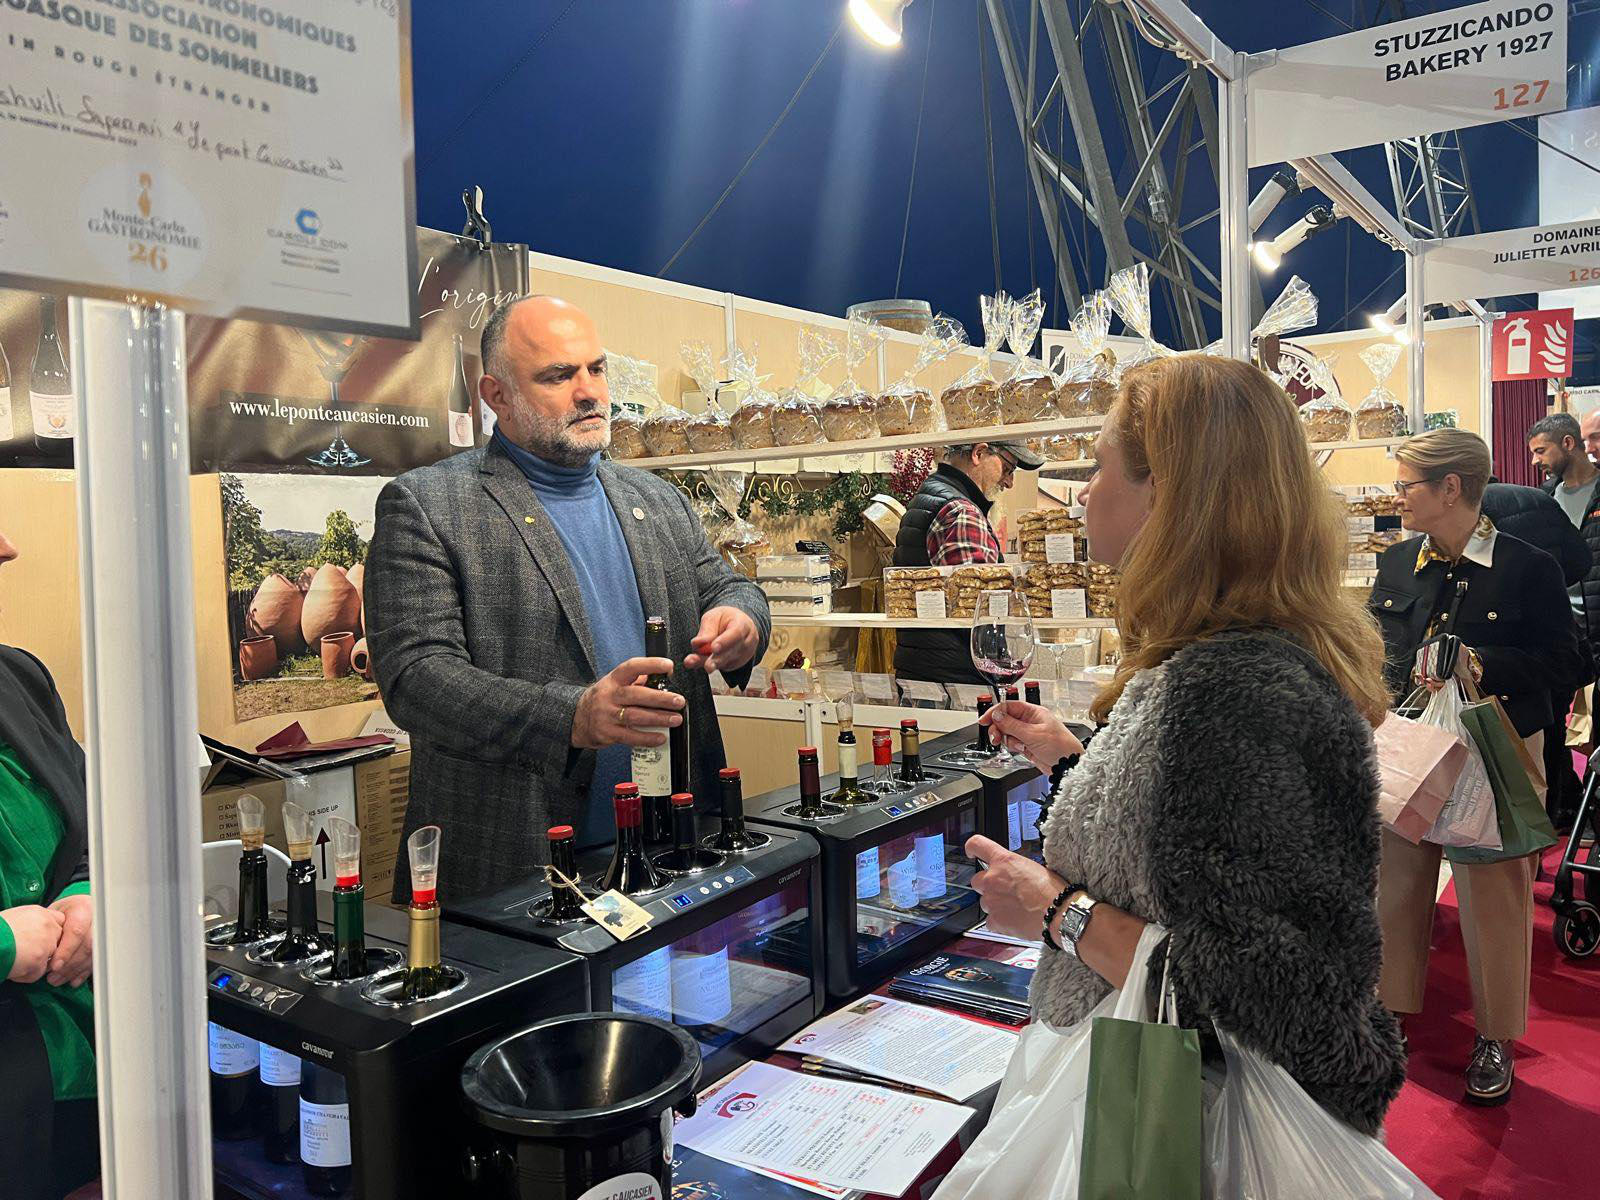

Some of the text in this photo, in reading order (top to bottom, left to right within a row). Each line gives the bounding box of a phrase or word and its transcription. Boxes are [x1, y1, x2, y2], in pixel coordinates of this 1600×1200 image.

[103, 0, 257, 49] SSOCIATION
[198, 0, 356, 52] RONOMIQUES
[1374, 3, 1554, 57] STUZZICANDO
[54, 45, 138, 78] ROUGE
[129, 22, 172, 52] DES
[179, 38, 319, 94] SOMMELIERS
[1386, 31, 1554, 81] BAKERY 1927
[1493, 79, 1550, 111] 127
[87, 217, 201, 250] GASTRONOMIE
[1533, 225, 1600, 244] DOMAINE
[127, 241, 168, 272] 26
[1494, 241, 1600, 264] JULIETTE AVRIL
[1569, 267, 1600, 282] 126
[229, 399, 430, 427] www.lepontcaucasien.com
[316, 806, 330, 815] SIDE
[330, 804, 339, 812] UP
